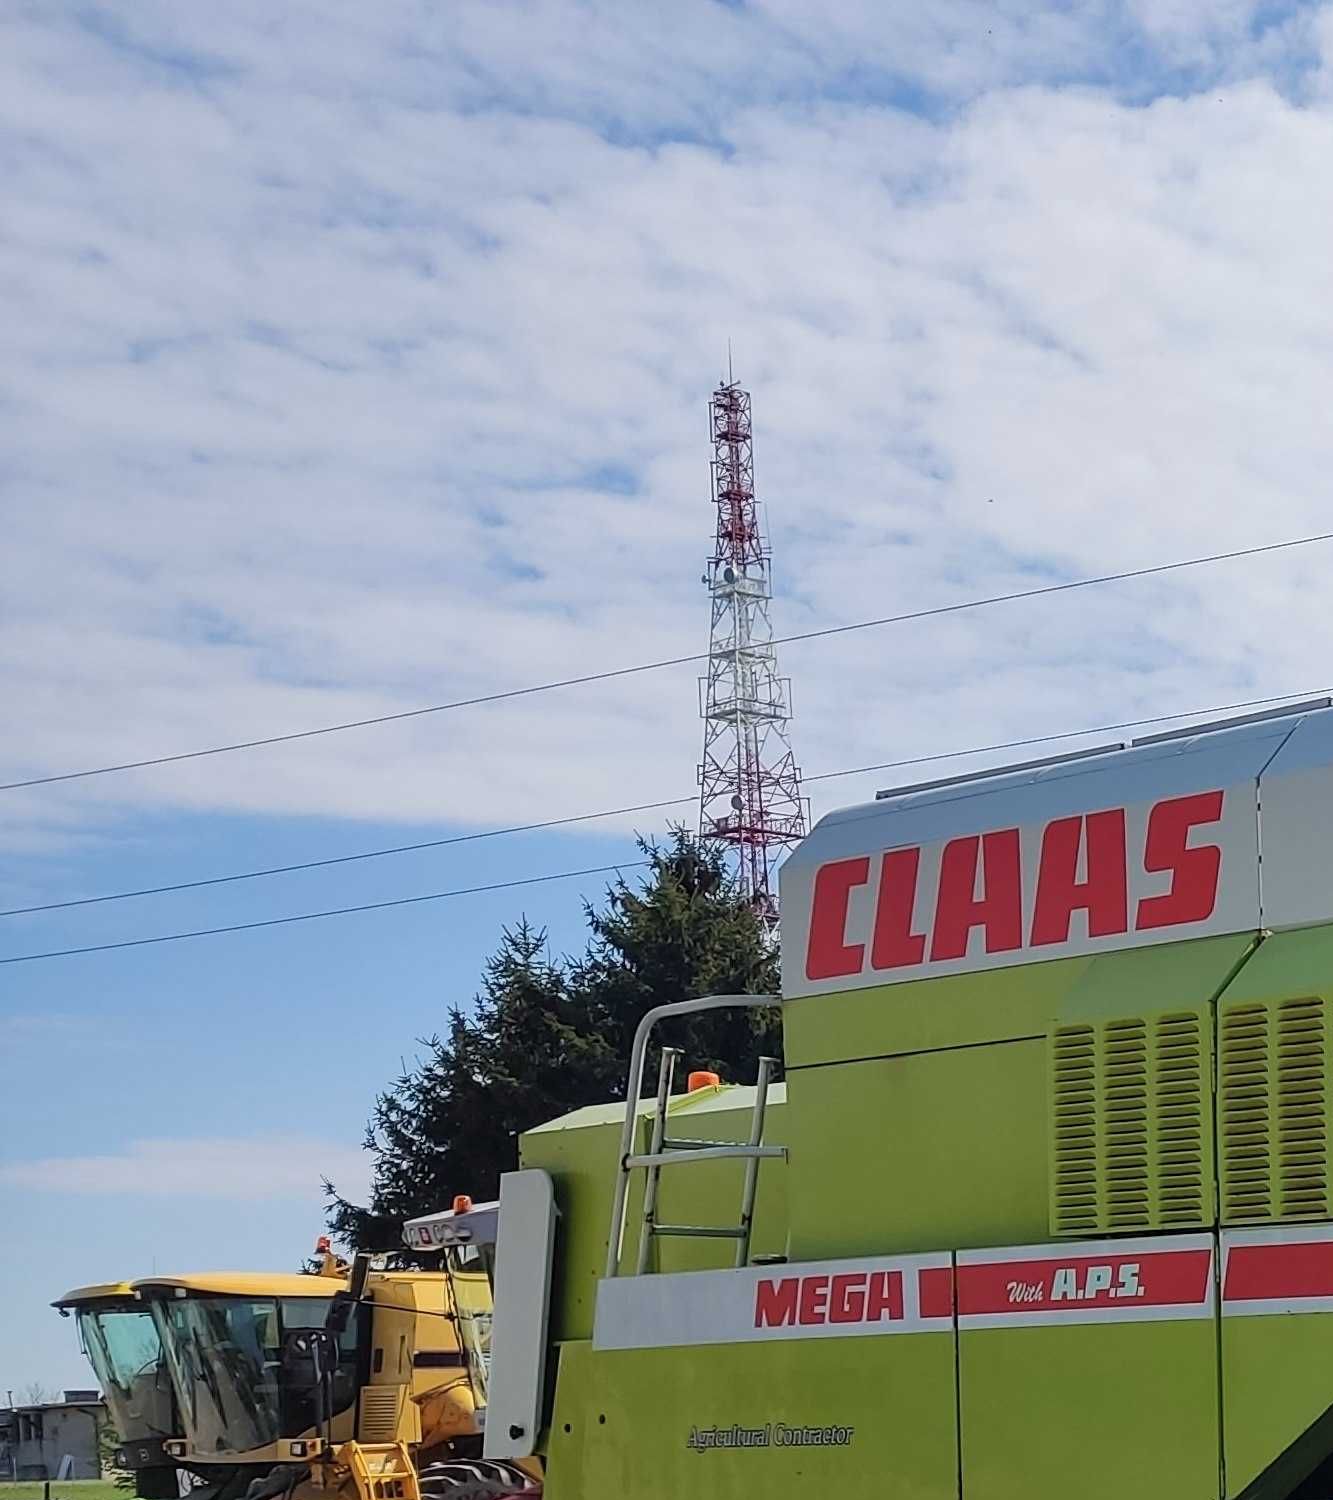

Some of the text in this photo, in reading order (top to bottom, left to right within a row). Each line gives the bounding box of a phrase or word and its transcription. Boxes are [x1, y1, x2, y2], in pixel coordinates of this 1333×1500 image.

[805, 789, 1225, 981] CLAAS
[755, 1270, 905, 1328] MEGA
[1006, 1262, 1145, 1303] With A.P.S.
[686, 1421, 854, 1454] Agricultural Contractor
